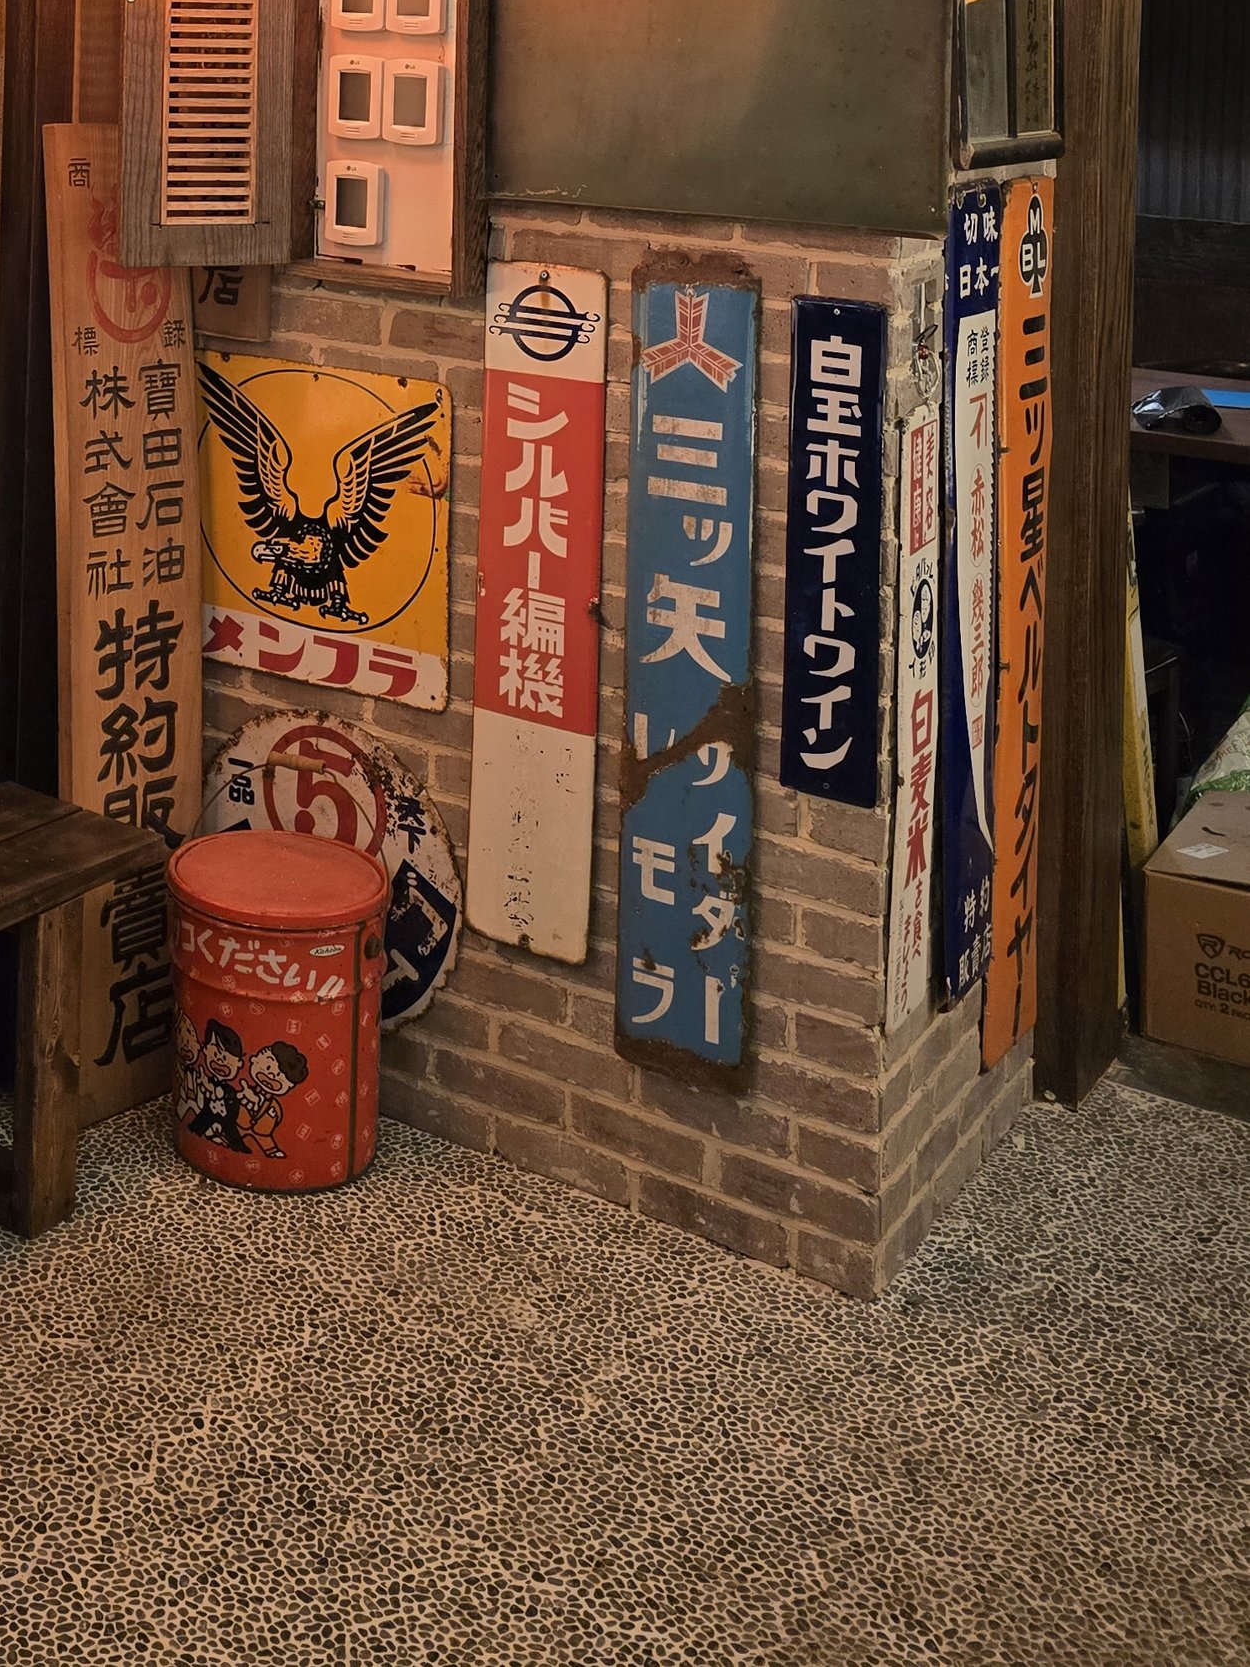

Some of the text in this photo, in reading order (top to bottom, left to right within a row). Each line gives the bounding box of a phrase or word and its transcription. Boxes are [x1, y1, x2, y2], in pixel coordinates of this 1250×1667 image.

[498, 381, 568, 718] シルバー編機
[800, 336, 861, 769] 白玉ホワイトワイン
[1219, 1002, 1230, 1015] 2
